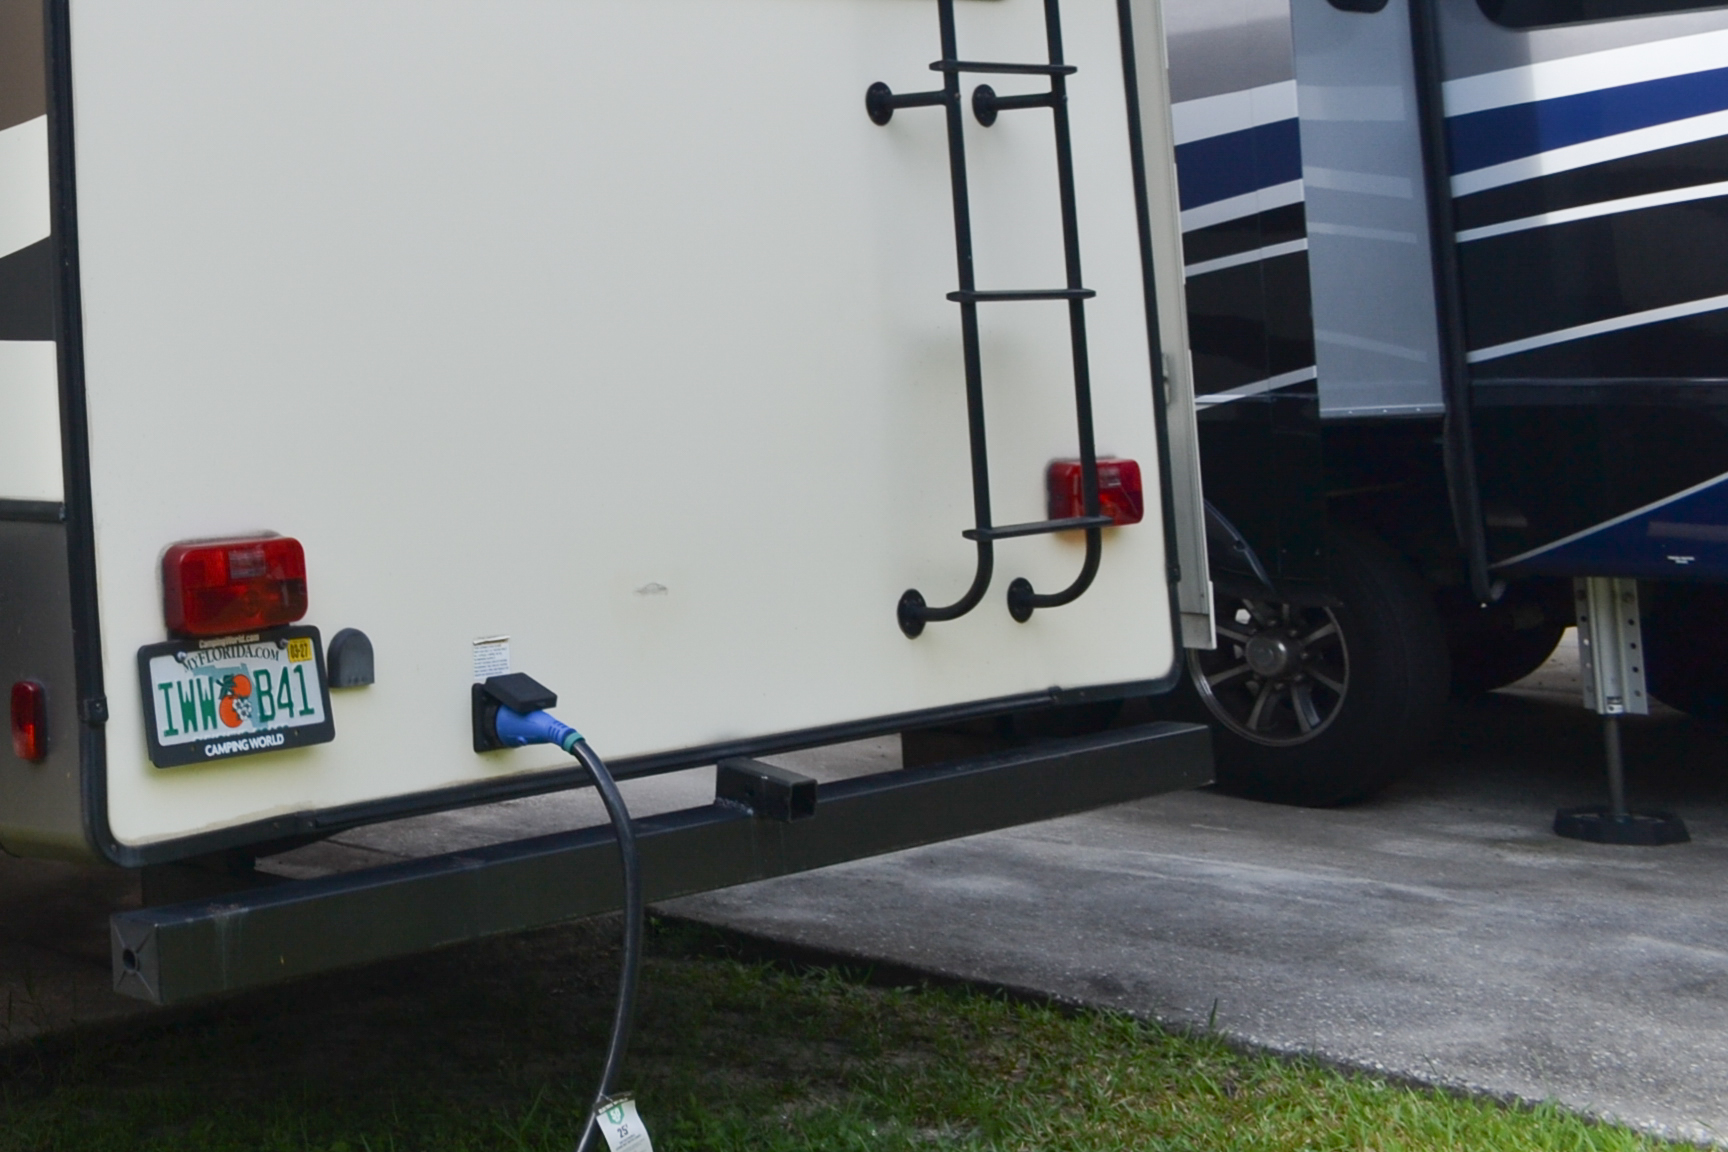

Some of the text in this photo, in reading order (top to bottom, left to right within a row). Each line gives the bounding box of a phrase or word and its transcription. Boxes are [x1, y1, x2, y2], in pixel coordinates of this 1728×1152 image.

[183, 645, 280, 672] MYFLORIDA.COM
[253, 664, 315, 723] B41
[205, 739, 248, 757] CAMPING
[249, 733, 284, 750] WORLD
